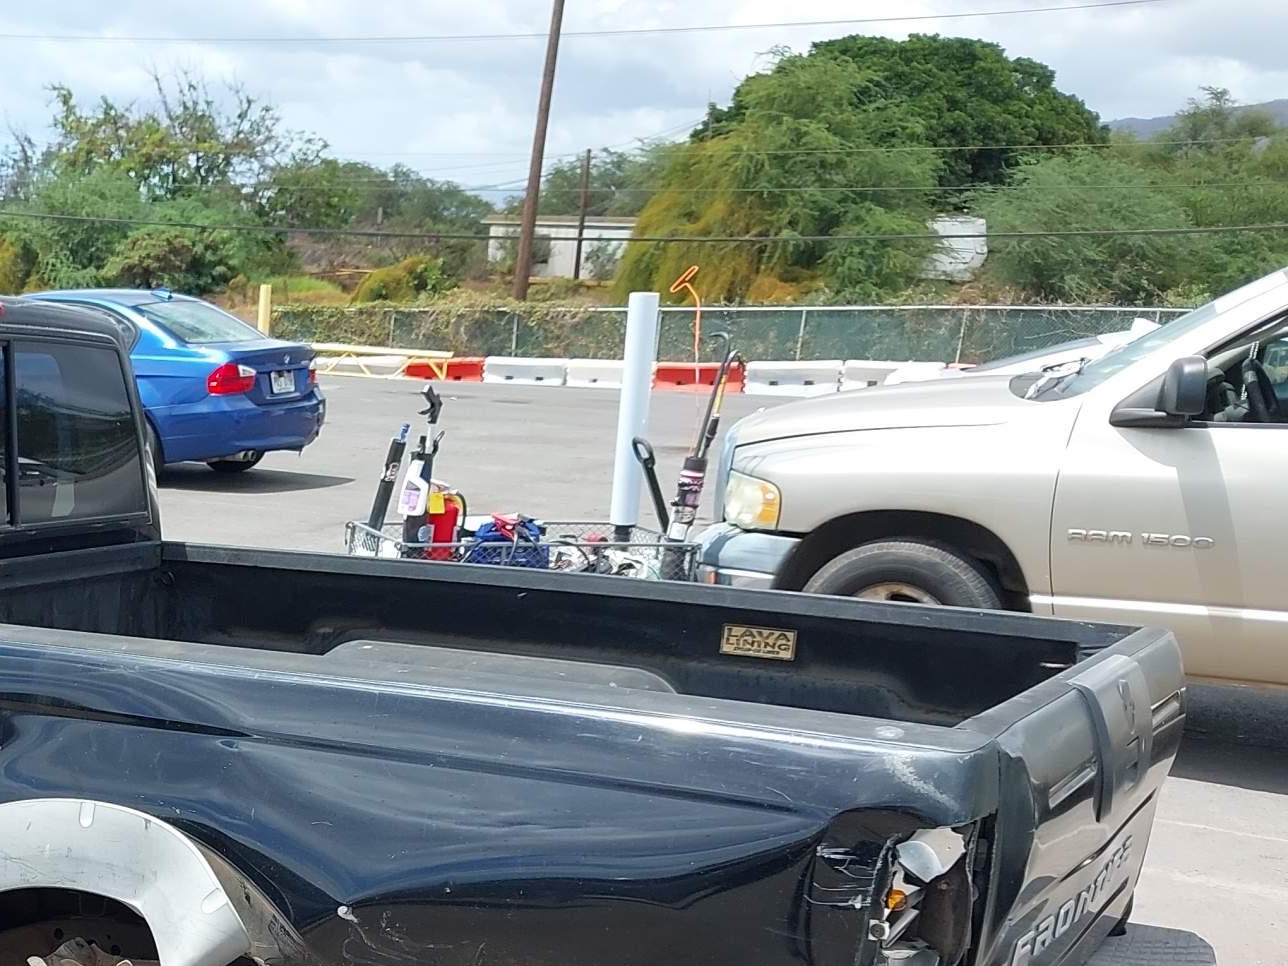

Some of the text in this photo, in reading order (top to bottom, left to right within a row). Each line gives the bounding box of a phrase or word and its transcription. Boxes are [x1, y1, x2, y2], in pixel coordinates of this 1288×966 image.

[1067, 528, 1216, 549] RAM 1500
[725, 627, 791, 643] LAVA
[725, 637, 791, 651] LINING
